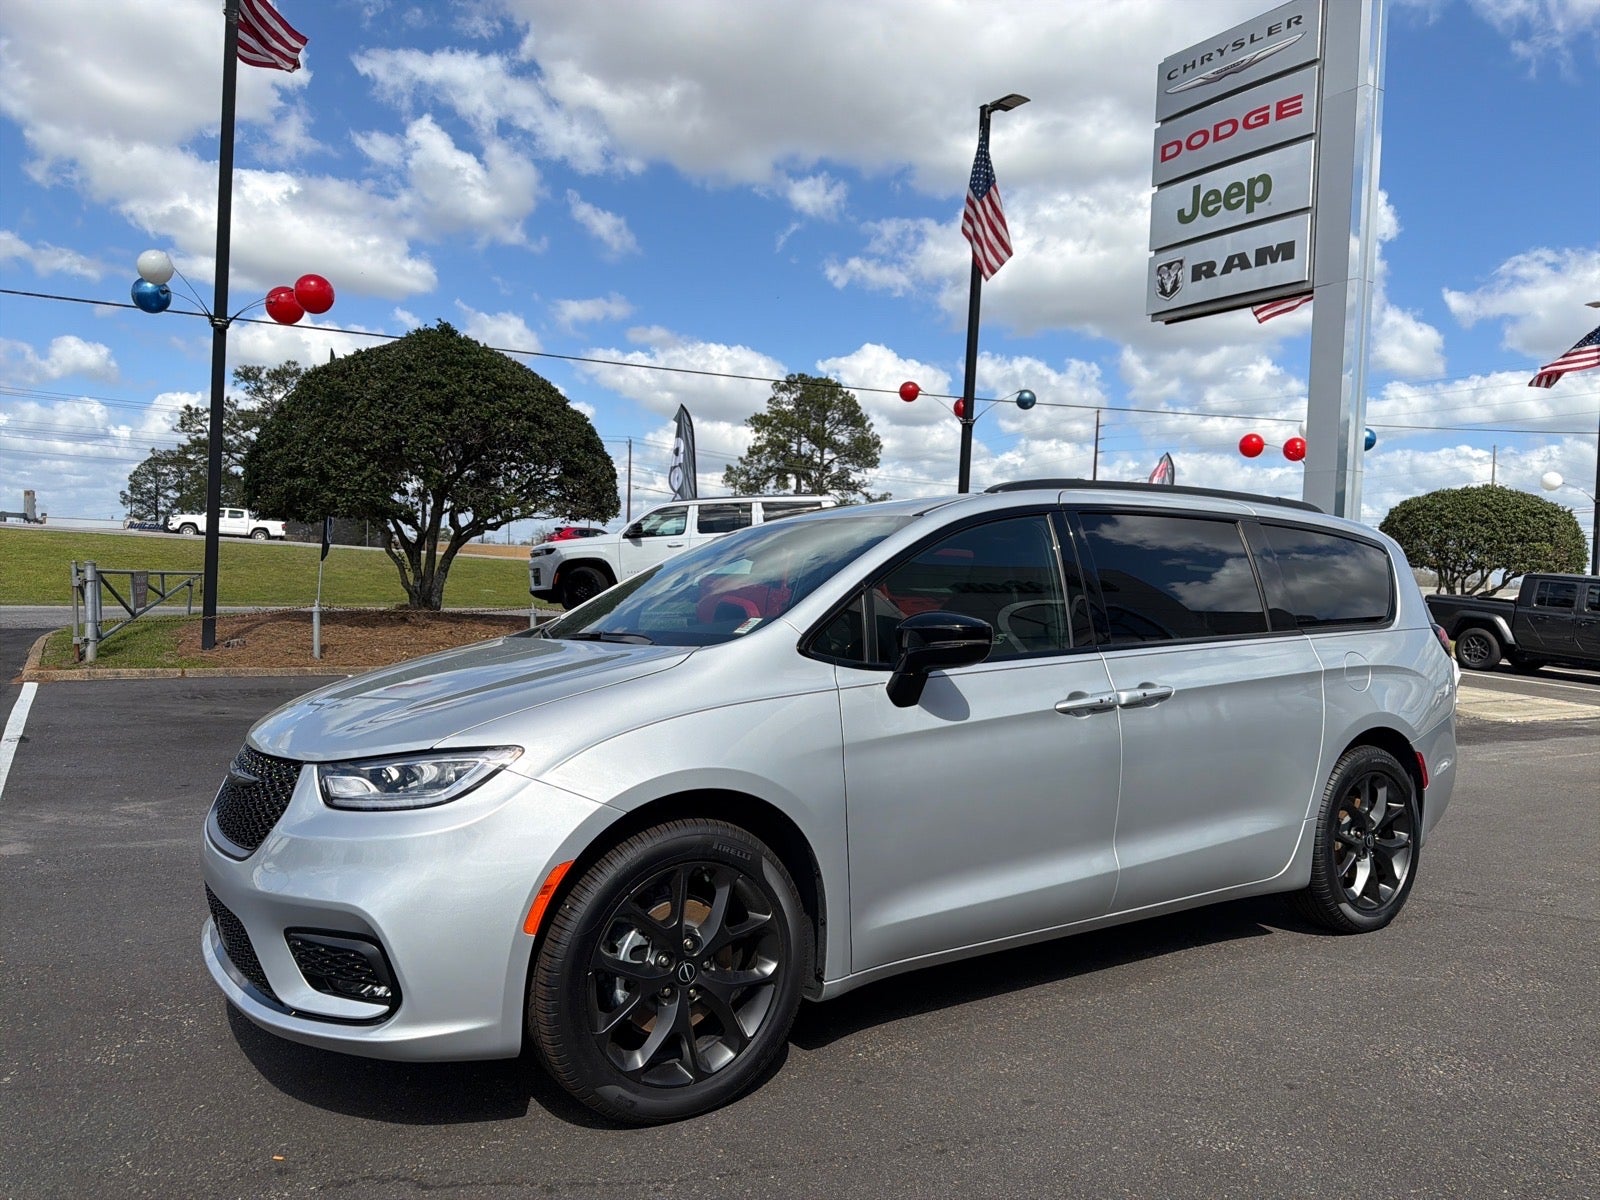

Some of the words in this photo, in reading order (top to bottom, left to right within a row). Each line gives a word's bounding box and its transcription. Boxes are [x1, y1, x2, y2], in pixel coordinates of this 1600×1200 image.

[1167, 15, 1303, 81] CHRYSLER
[1160, 94, 1304, 163] DODGE
[1177, 173, 1273, 225] Jeep
[1191, 240, 1296, 283] RAM
